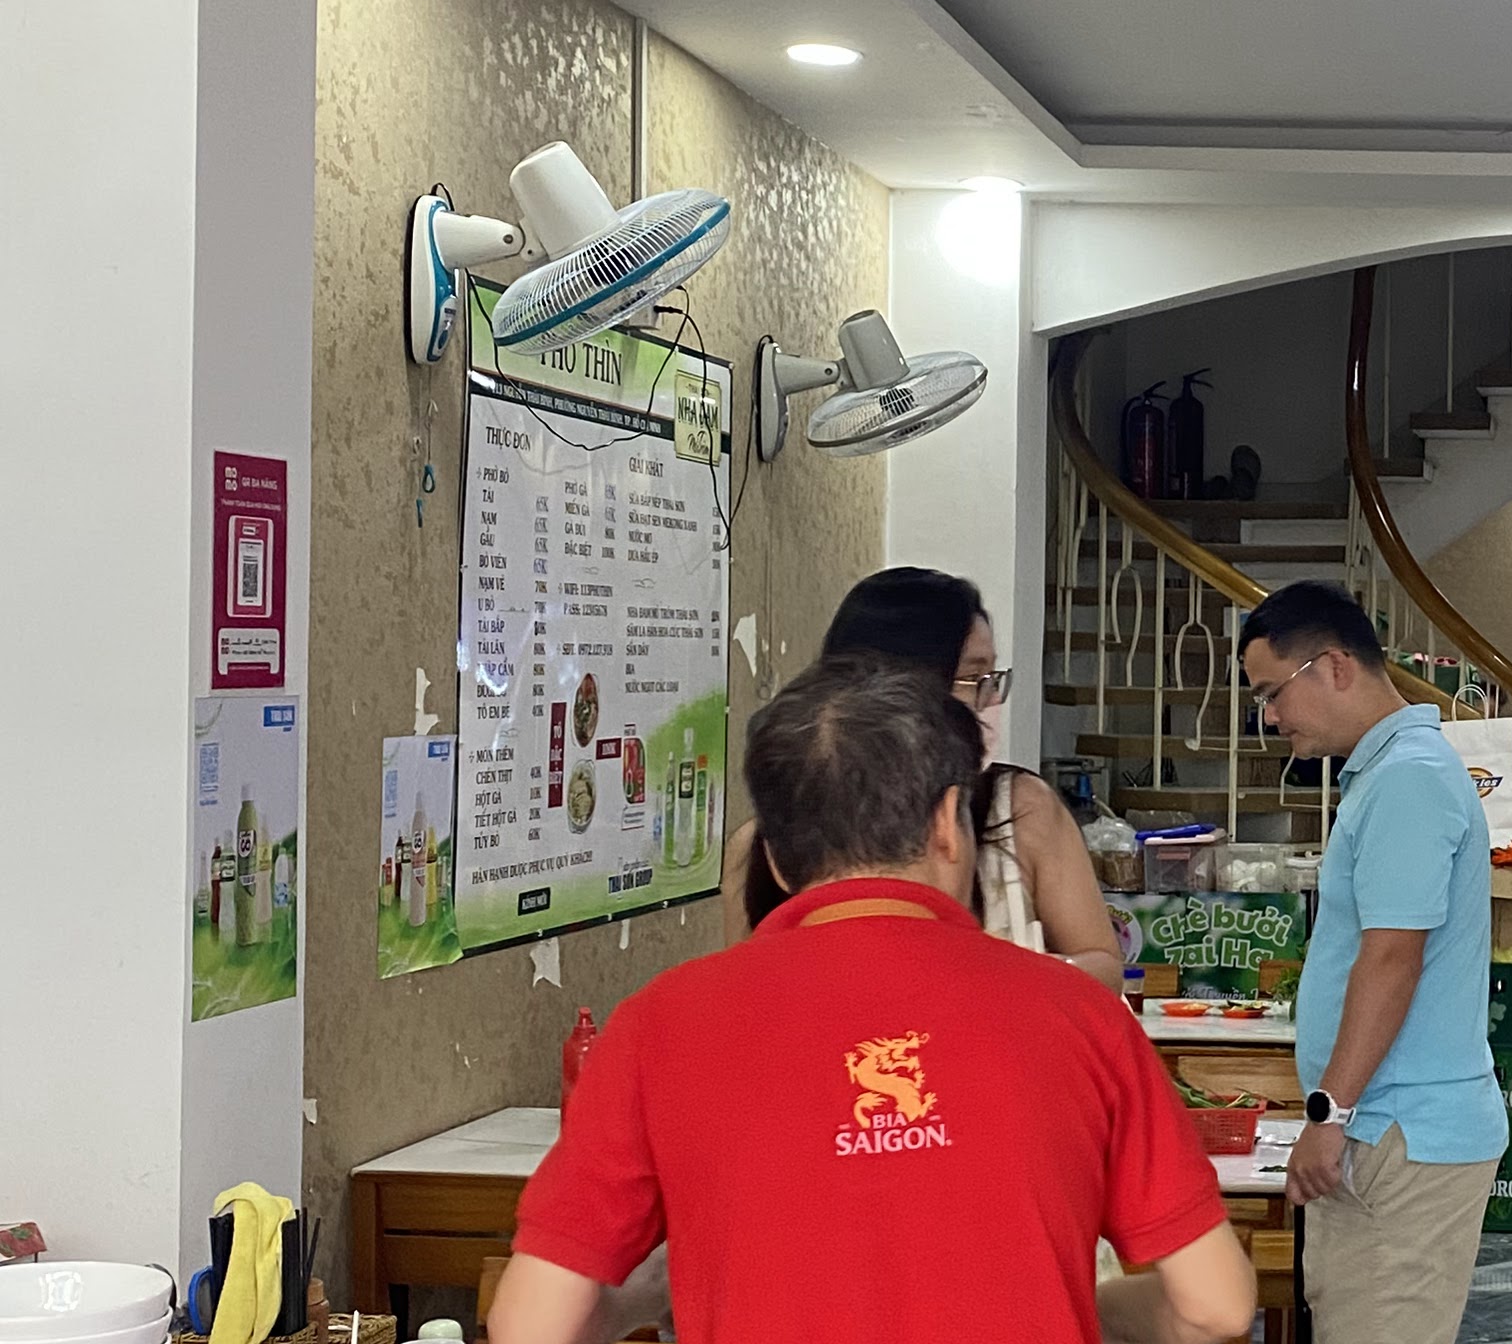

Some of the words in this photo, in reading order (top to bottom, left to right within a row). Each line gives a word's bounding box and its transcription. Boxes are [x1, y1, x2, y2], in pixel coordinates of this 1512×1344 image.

[582, 339, 622, 386] THÌN
[485, 426, 511, 450] THỰC
[1151, 896, 1209, 946] Chè
[1211, 901, 1293, 948] bưởi
[872, 1112, 907, 1129] BIA
